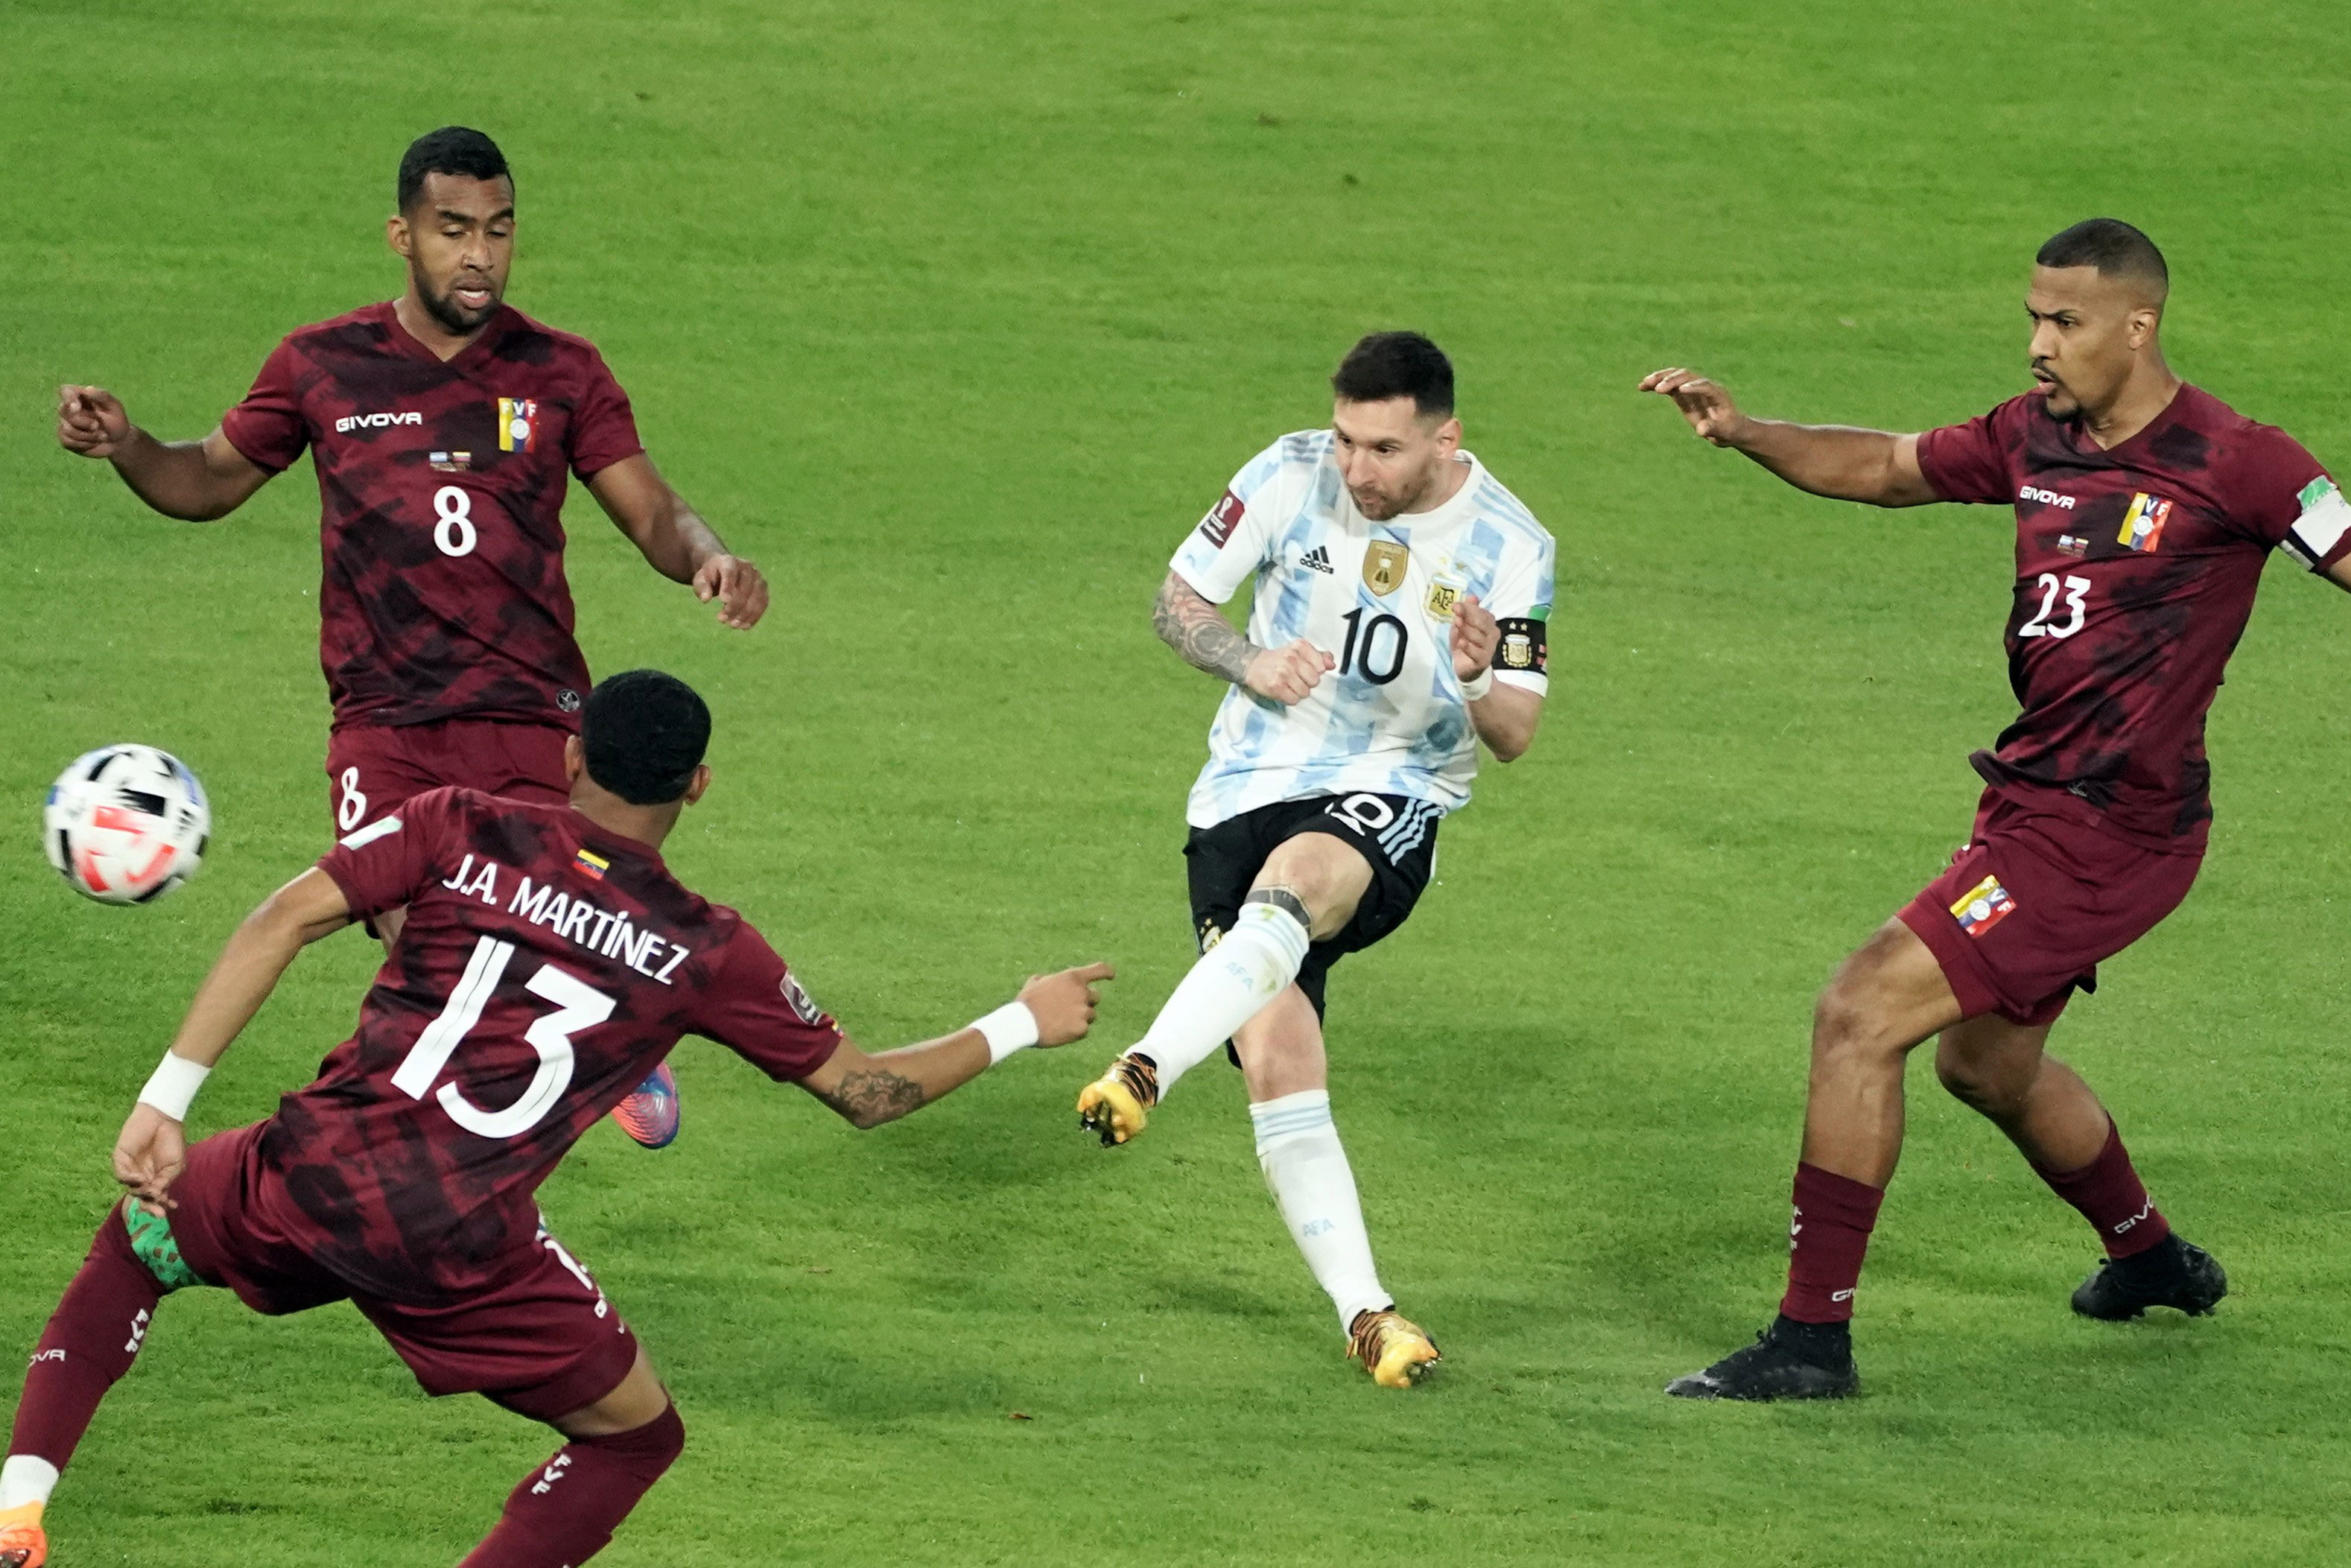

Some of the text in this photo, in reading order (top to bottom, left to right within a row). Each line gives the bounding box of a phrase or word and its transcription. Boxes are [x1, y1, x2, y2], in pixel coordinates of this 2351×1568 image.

[336, 412, 422, 432] GIVOVA
[501, 401, 536, 417] FVF
[434, 486, 478, 557] 8
[2020, 486, 2076, 510] GIVOVA
[2132, 496, 2168, 516] FVF
[2018, 573, 2092, 638] 23
[1339, 606, 1409, 685] 10
[339, 766, 367, 831] 8
[442, 854, 691, 985] J.A. MARTÍNEZ
[390, 934, 618, 1139] 13
[530, 1453, 573, 1495] FVF
